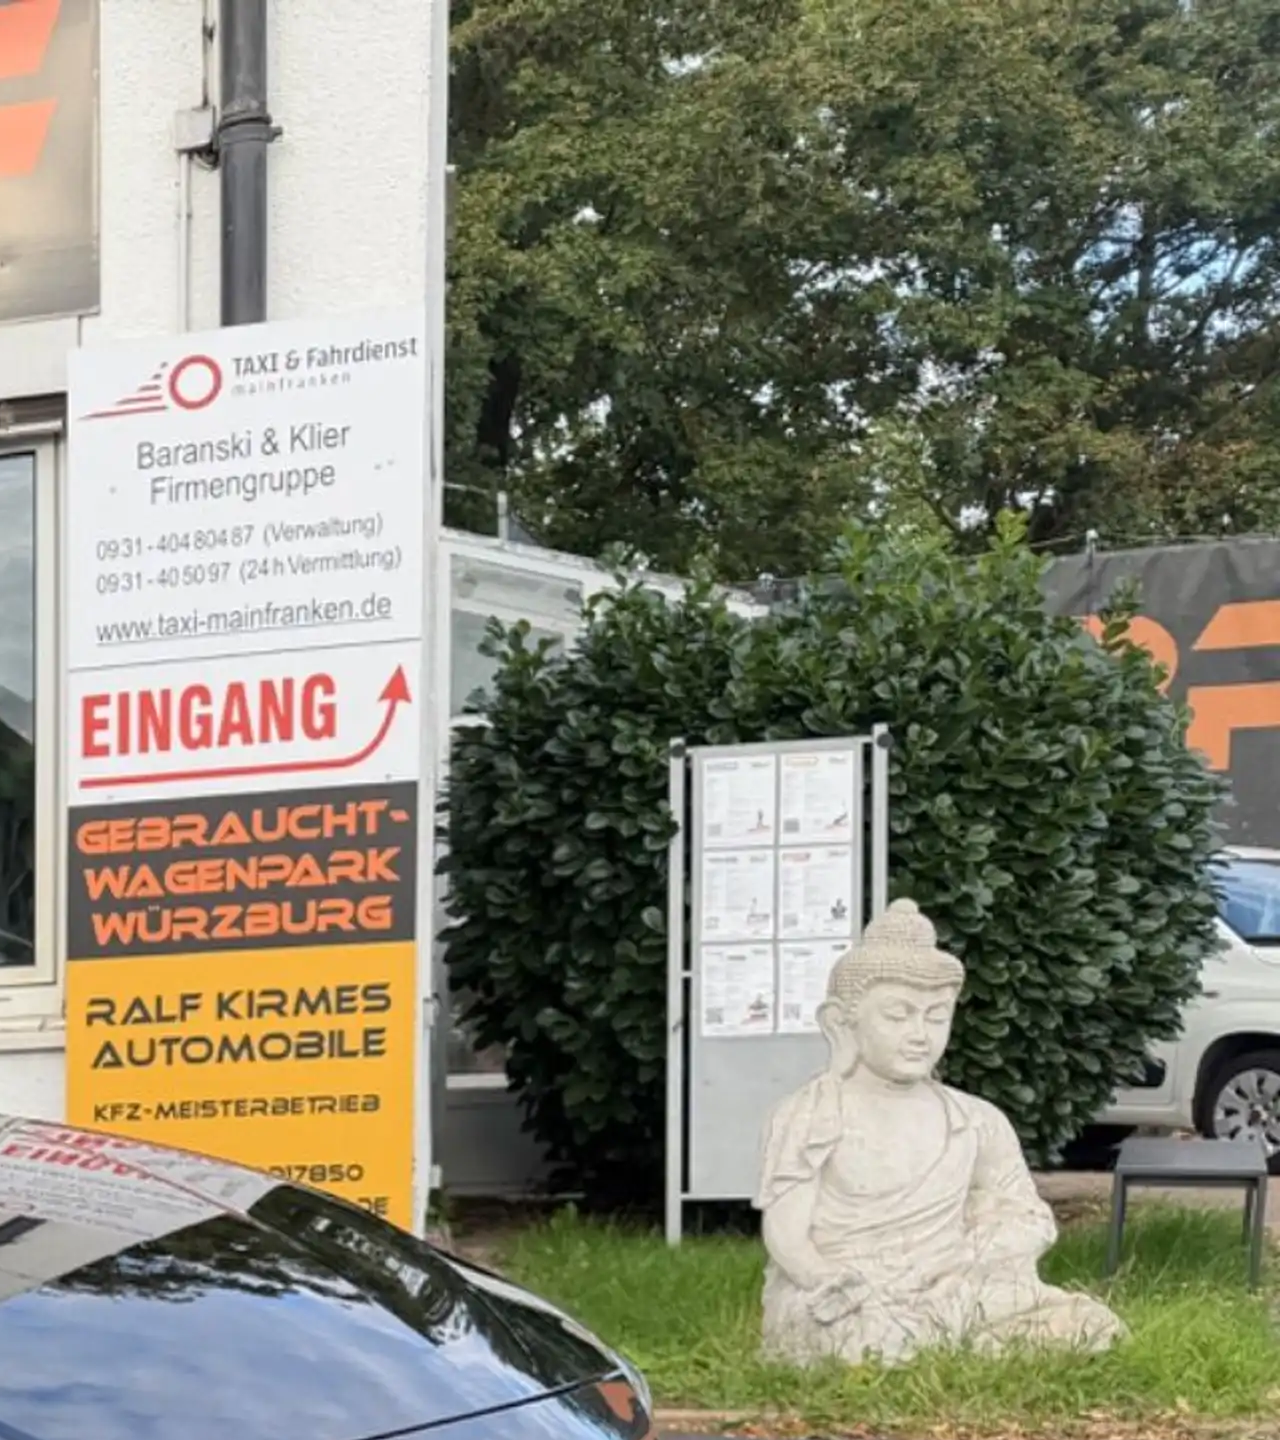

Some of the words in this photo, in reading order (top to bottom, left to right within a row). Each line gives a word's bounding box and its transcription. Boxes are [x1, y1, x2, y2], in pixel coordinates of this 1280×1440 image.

[232, 353, 279, 376] TAXI
[285, 349, 300, 371] &
[306, 337, 418, 370] Fahrdienst
[231, 372, 352, 396] mainfranken
[137, 430, 253, 471] Baranski
[261, 427, 280, 457] &
[290, 422, 351, 453] Klier
[150, 462, 336, 505] Firmengruppe
[263, 512, 383, 548] (Verwaltung)
[287, 544, 402, 576] Vermittlung)
[96, 592, 392, 642] www.taxi-mainfranken.de
[81, 672, 338, 759] EINGANG
[76, 799, 410, 856] GEBRAUCHT-
[83, 846, 401, 901] WAGENPARK
[91, 893, 394, 946] WÜRZBURG
[85, 992, 203, 1028] RALF
[215, 981, 393, 1022] KIRMES
[90, 1027, 388, 1070] AUTOMOBILE
[92, 1093, 381, 1122] KFZ-MEISTERBETRIEB
